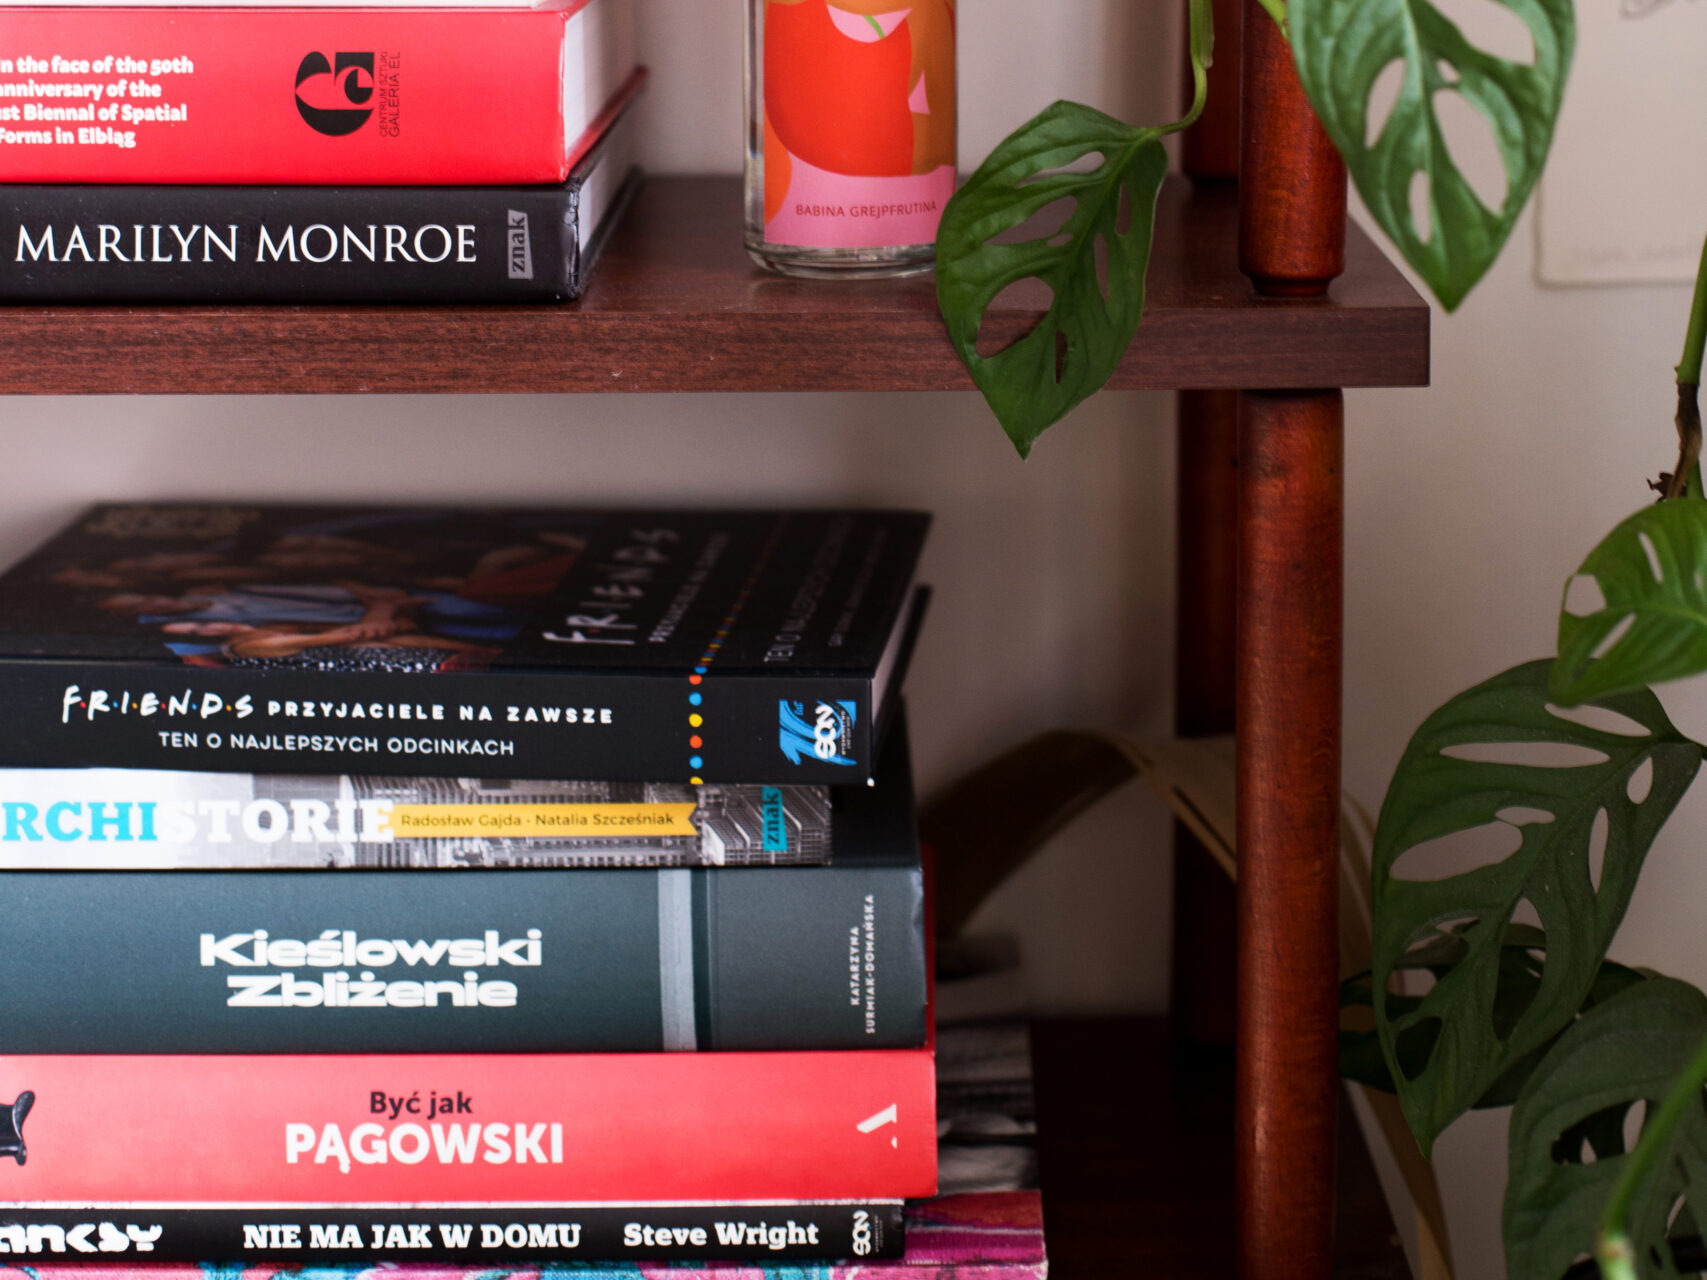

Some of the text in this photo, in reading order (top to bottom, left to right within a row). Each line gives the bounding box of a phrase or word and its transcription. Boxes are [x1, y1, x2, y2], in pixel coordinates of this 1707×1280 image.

[16, 55, 49, 73] the
[51, 55, 90, 73] face
[92, 55, 114, 73] of
[115, 55, 148, 73] the
[150, 55, 194, 76] 50th
[106, 79, 127, 97] of
[129, 79, 162, 97] the
[388, 51, 400, 137] GALERIA EL
[23, 103, 95, 121] Biennal
[97, 103, 119, 121] of
[121, 103, 188, 124] Spatial
[55, 127, 75, 144] in
[796, 200, 938, 219] BABINA GREJPFRUTINA
[15, 224, 477, 263] MARILYN MONROE
[508, 216, 526, 273] znak
[267, 701, 444, 719] PRZYJACIELE
[459, 706, 493, 721] NA
[506, 706, 613, 724] ZAWSZE
[159, 731, 514, 756] TEN O NAJLEPSZYCH ODCINKACH
[401, 813, 475, 827] Radosław
[479, 813, 522, 830] Gajda
[536, 813, 588, 827] Natalia
[593, 810, 675, 827] Szcześniak
[763, 792, 780, 845] znak
[200, 928, 542, 967] Kieślowski
[850, 925, 860, 1006] KATARZYNA
[227, 970, 518, 1007] Zbliżenie
[370, 1091, 473, 1120] Być jak
[285, 1122, 563, 1174] PĄGOWSKI
[243, 1224, 301, 1249] NIE
[309, 1224, 364, 1249] MA
[371, 1224, 433, 1250] JAK
[440, 1224, 473, 1249] W
[480, 1224, 581, 1249] DOMU
[623, 1222, 707, 1247] Steve
[714, 1221, 819, 1251] Wright
